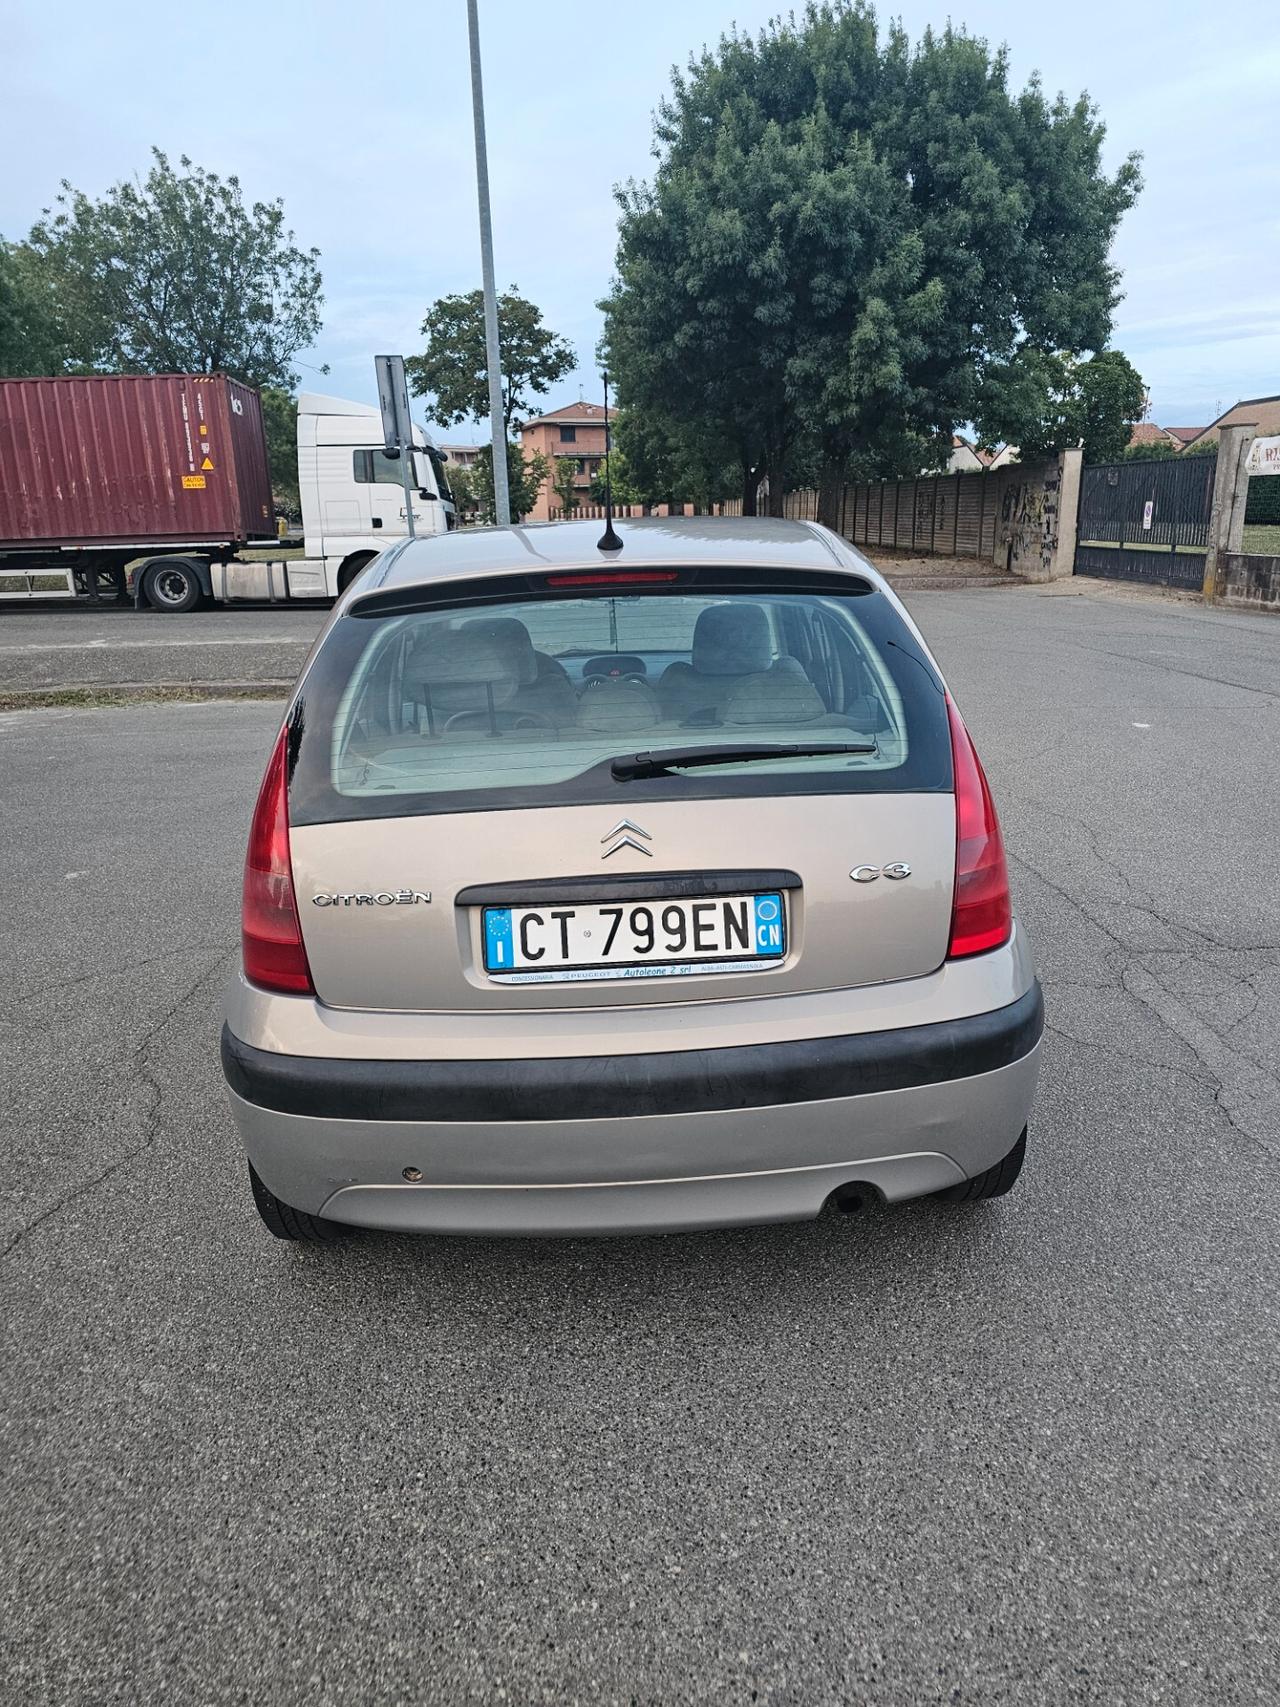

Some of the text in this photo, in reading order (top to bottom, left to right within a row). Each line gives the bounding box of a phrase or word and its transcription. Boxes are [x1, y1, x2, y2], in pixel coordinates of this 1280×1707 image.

[849, 861, 912, 883] C3
[312, 889, 432, 907] CITROËN
[519, 901, 749, 961] CT 799EN
[757, 924, 780, 947] CN
[496, 941, 503, 963] I
[623, 968, 667, 977] Autoleone
[679, 965, 692, 975] srl
